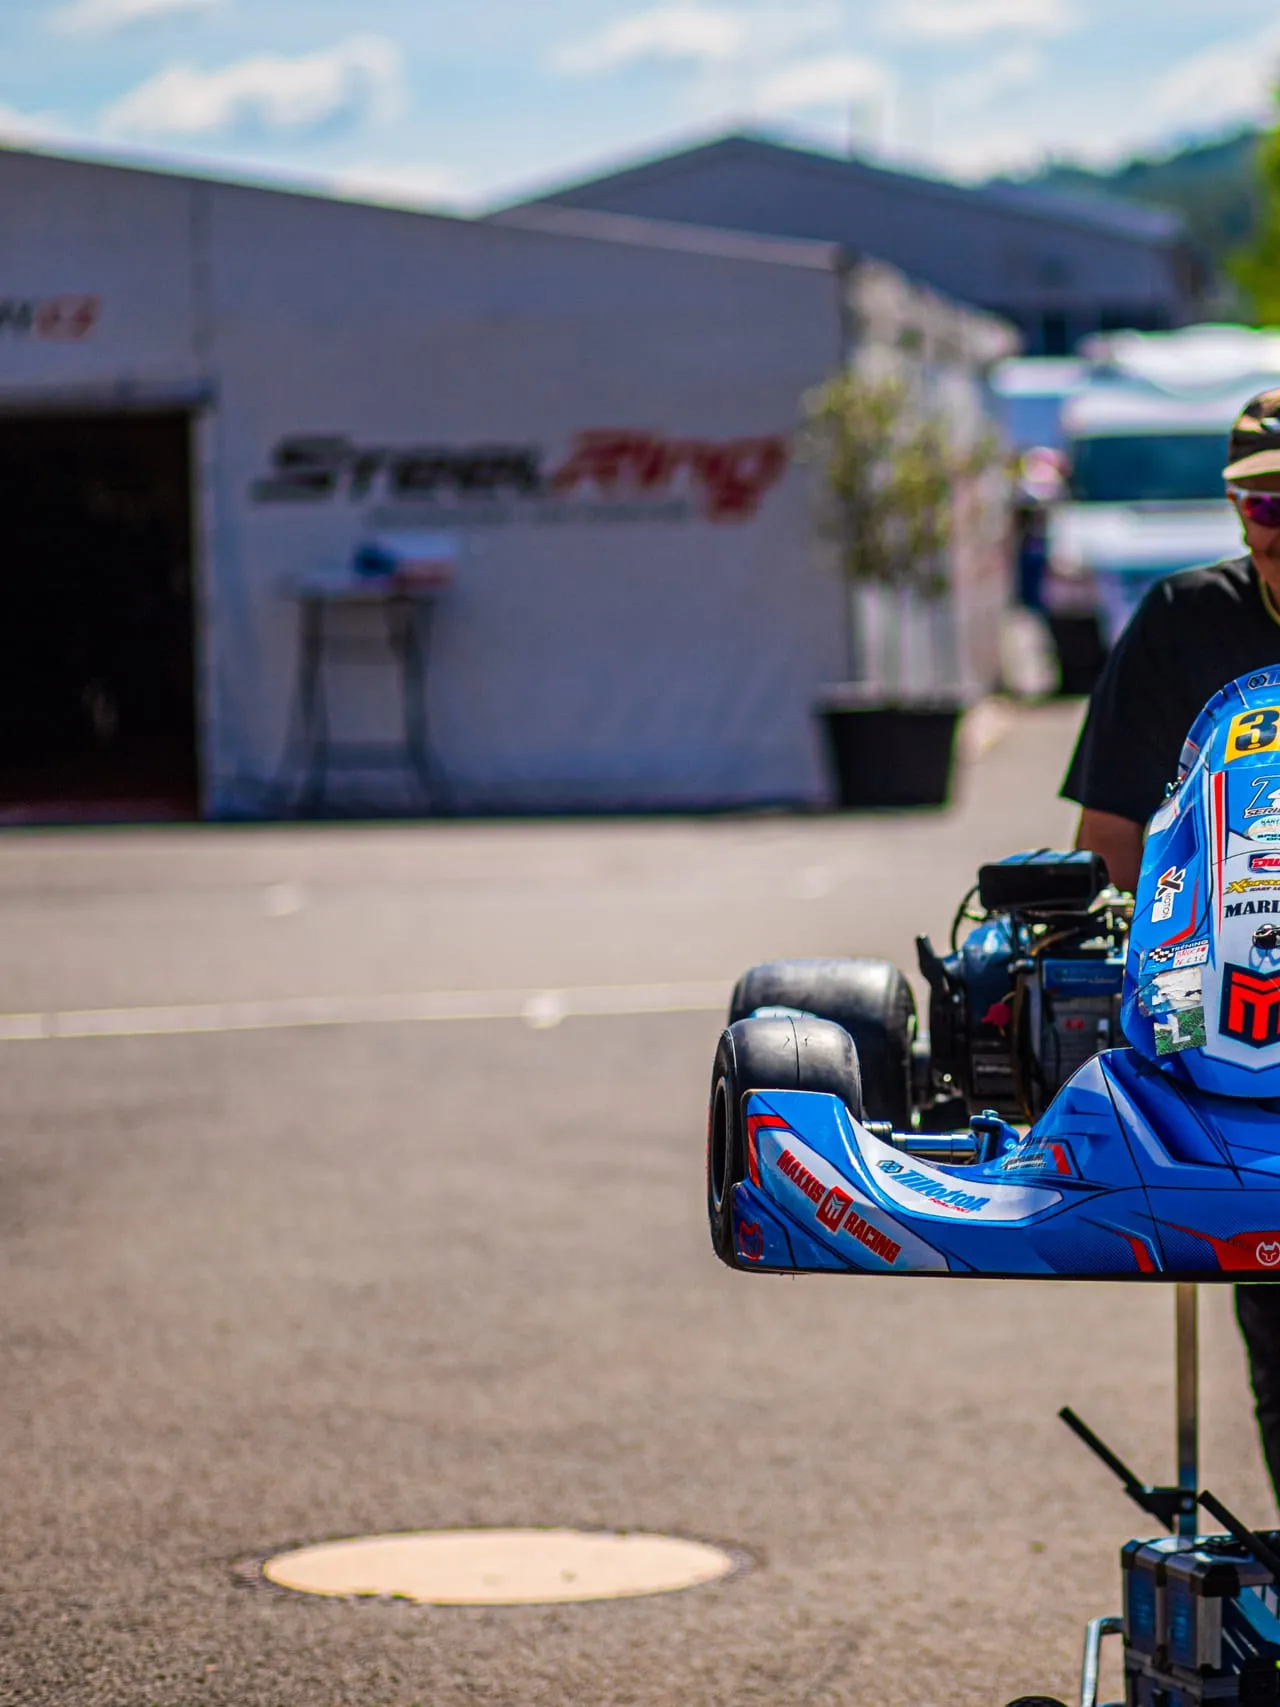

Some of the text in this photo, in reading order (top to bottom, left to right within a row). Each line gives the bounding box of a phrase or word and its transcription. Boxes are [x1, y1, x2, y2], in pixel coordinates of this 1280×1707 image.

[776, 1148, 827, 1204] MAXXIS
[842, 1211, 902, 1264] RACING
[890, 1169, 991, 1212] Tillotson
